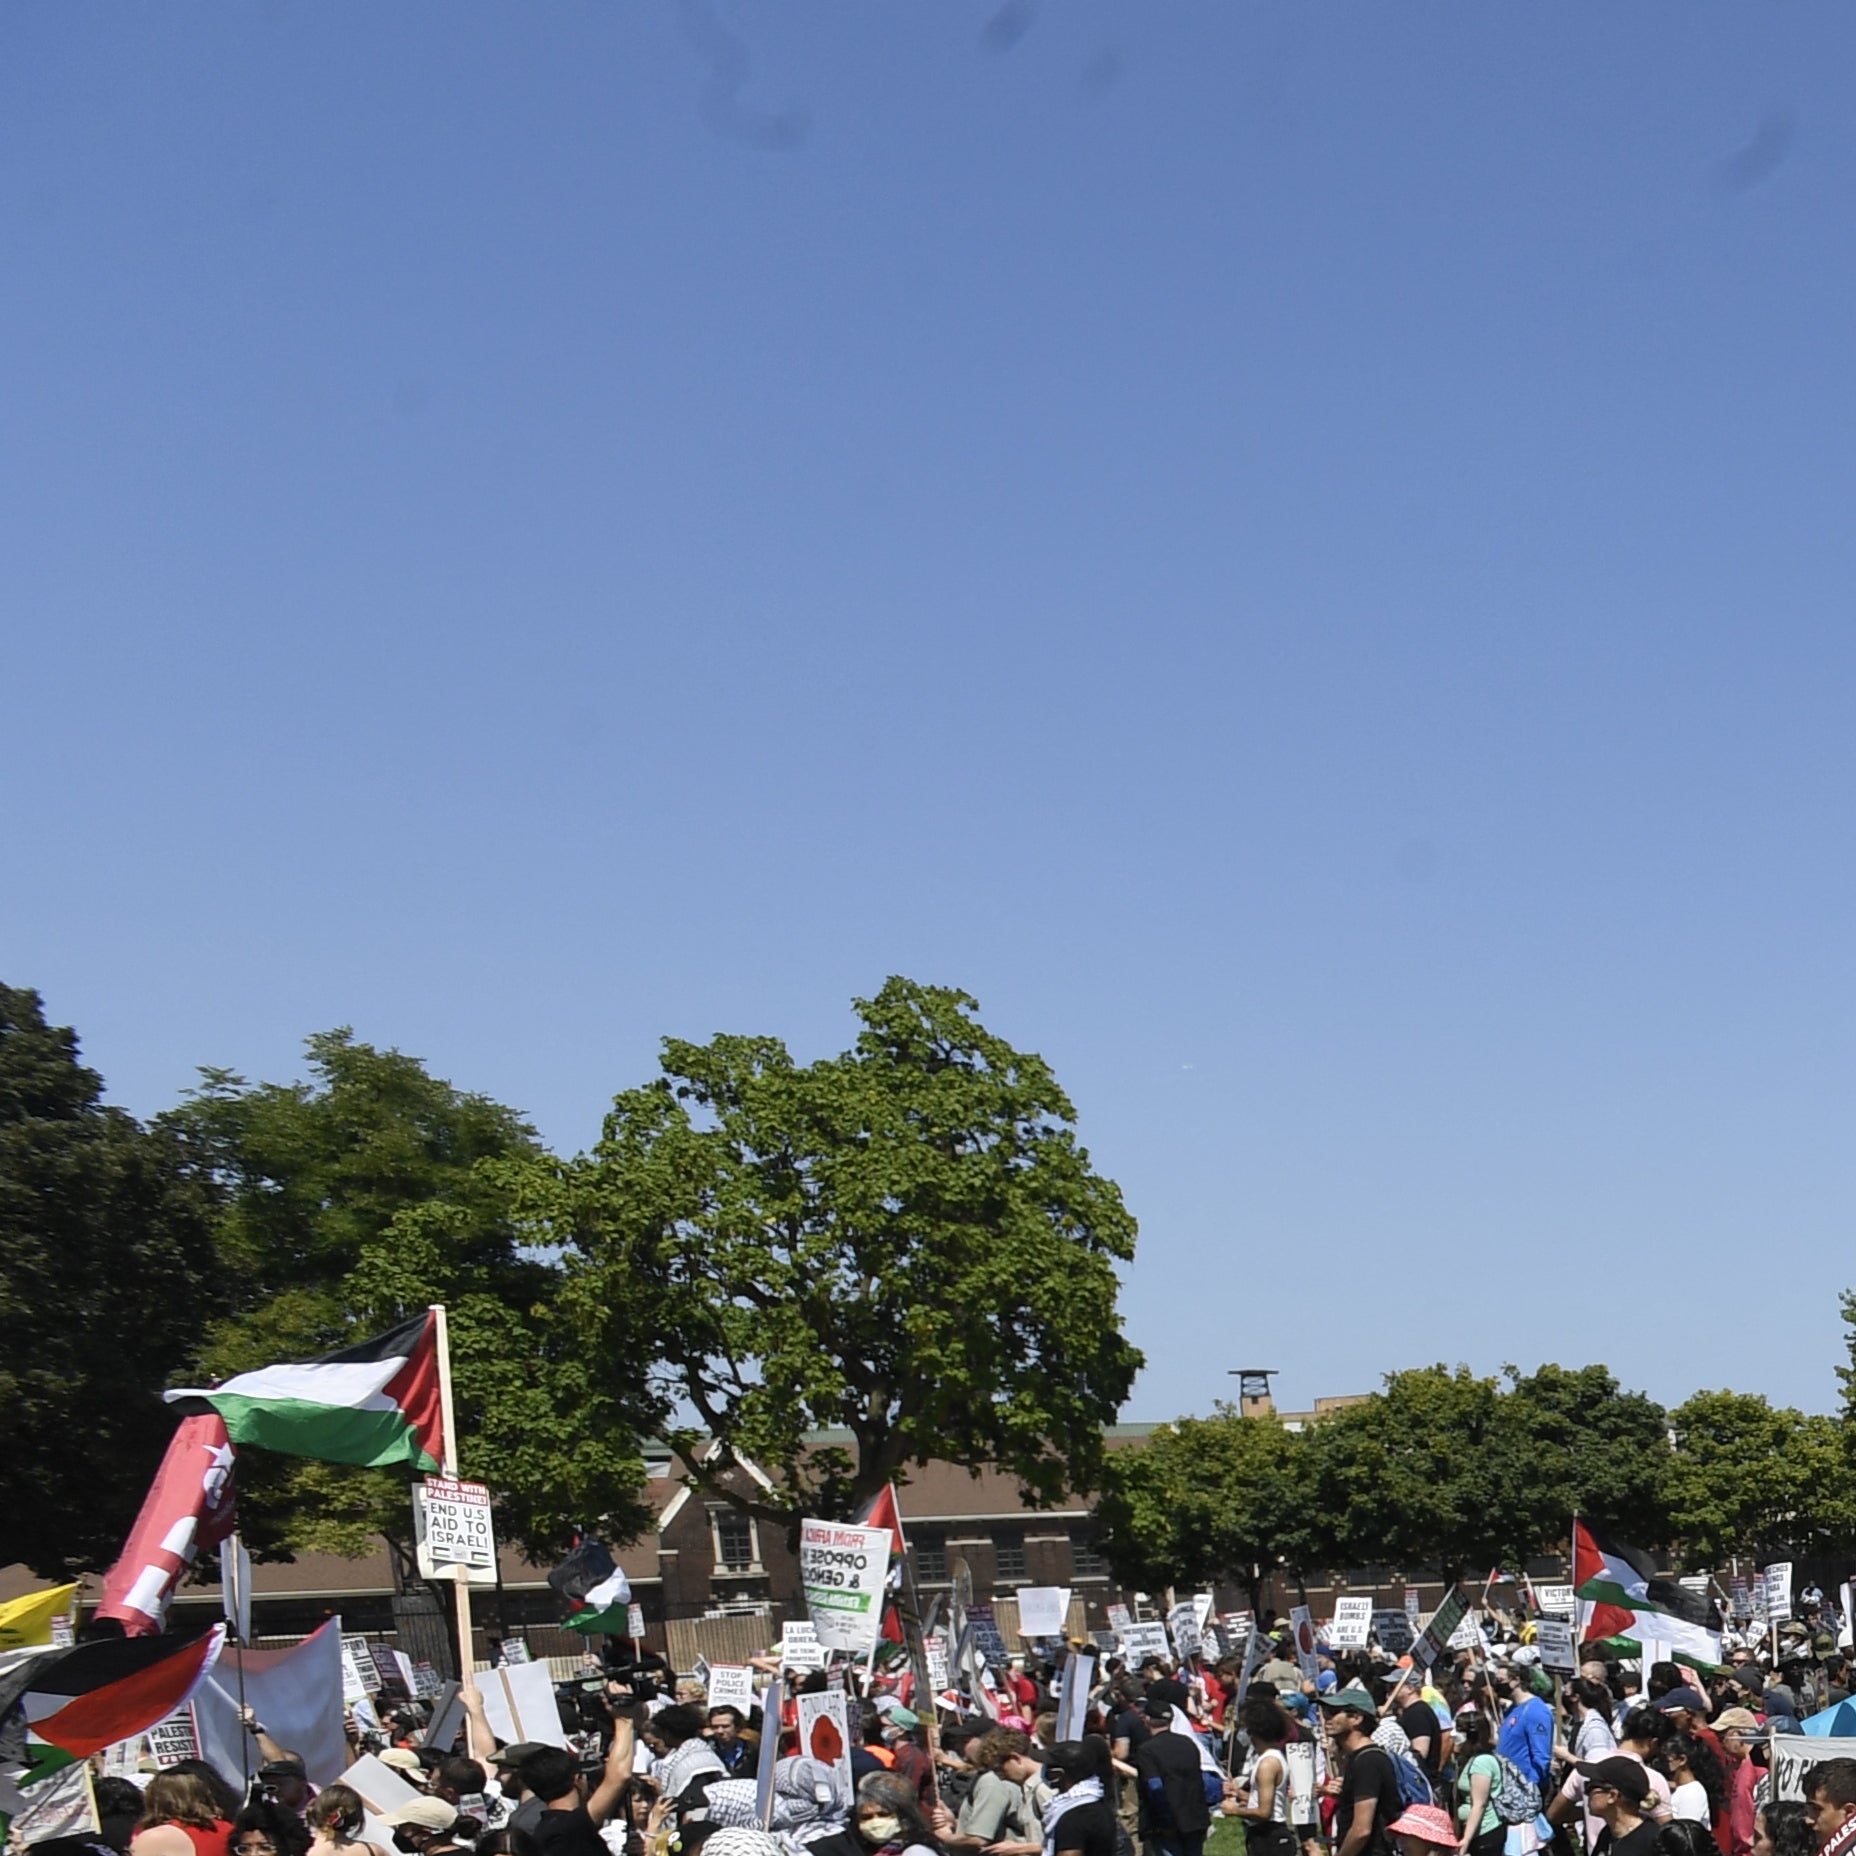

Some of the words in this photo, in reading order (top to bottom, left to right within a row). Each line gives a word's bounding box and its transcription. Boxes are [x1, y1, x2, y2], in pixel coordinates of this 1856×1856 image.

[426, 1478, 458, 1489] STAND
[461, 1483, 486, 1494] WITH
[431, 1503, 457, 1516] END
[463, 1508, 484, 1520] U.S
[432, 1516, 458, 1530] AID
[465, 1521, 487, 1534] TO
[432, 1531, 488, 1548] ISRAEL!
